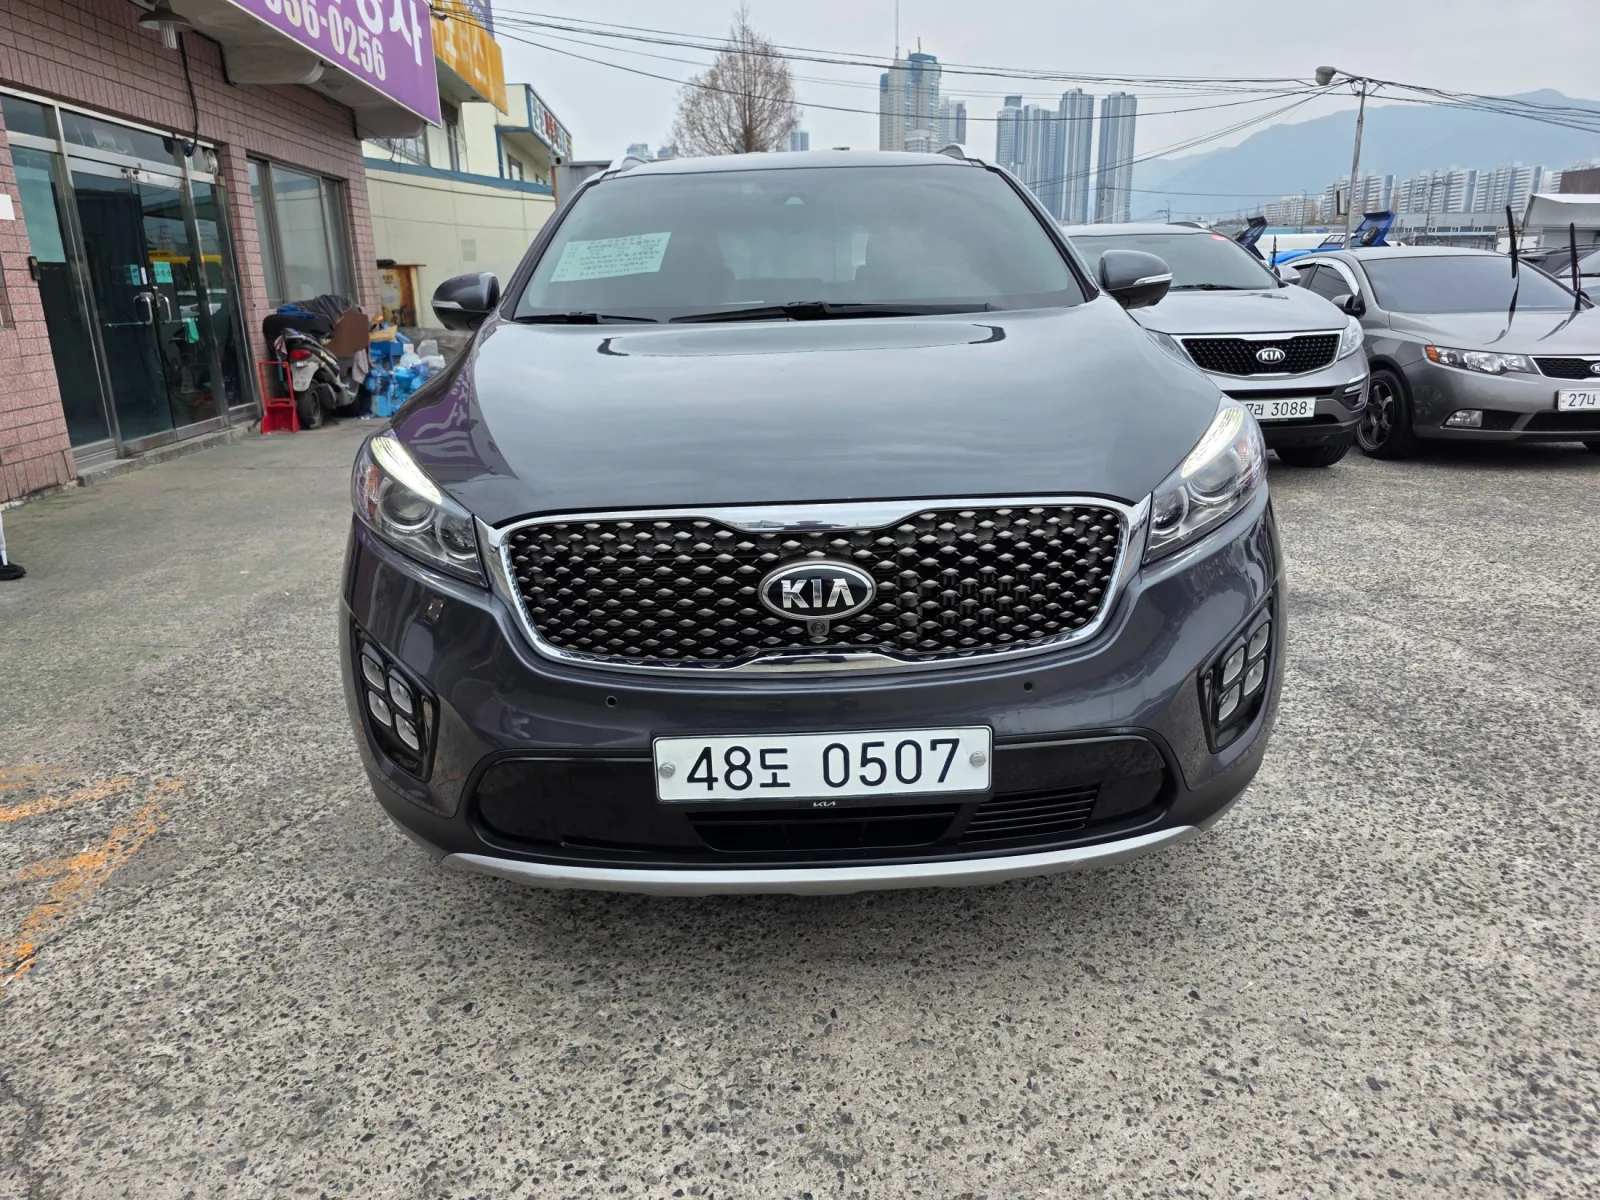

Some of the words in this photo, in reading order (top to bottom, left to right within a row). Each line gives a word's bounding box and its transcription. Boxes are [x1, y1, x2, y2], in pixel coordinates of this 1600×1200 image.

[264, 0, 386, 82] 6-0256
[1261, 351, 1281, 360] KIA
[1270, 401, 1308, 416] 3088
[1568, 393, 1596, 407] 27나
[780, 578, 855, 608] KIA
[686, 745, 791, 791] 48도
[822, 738, 960, 789] 0507
